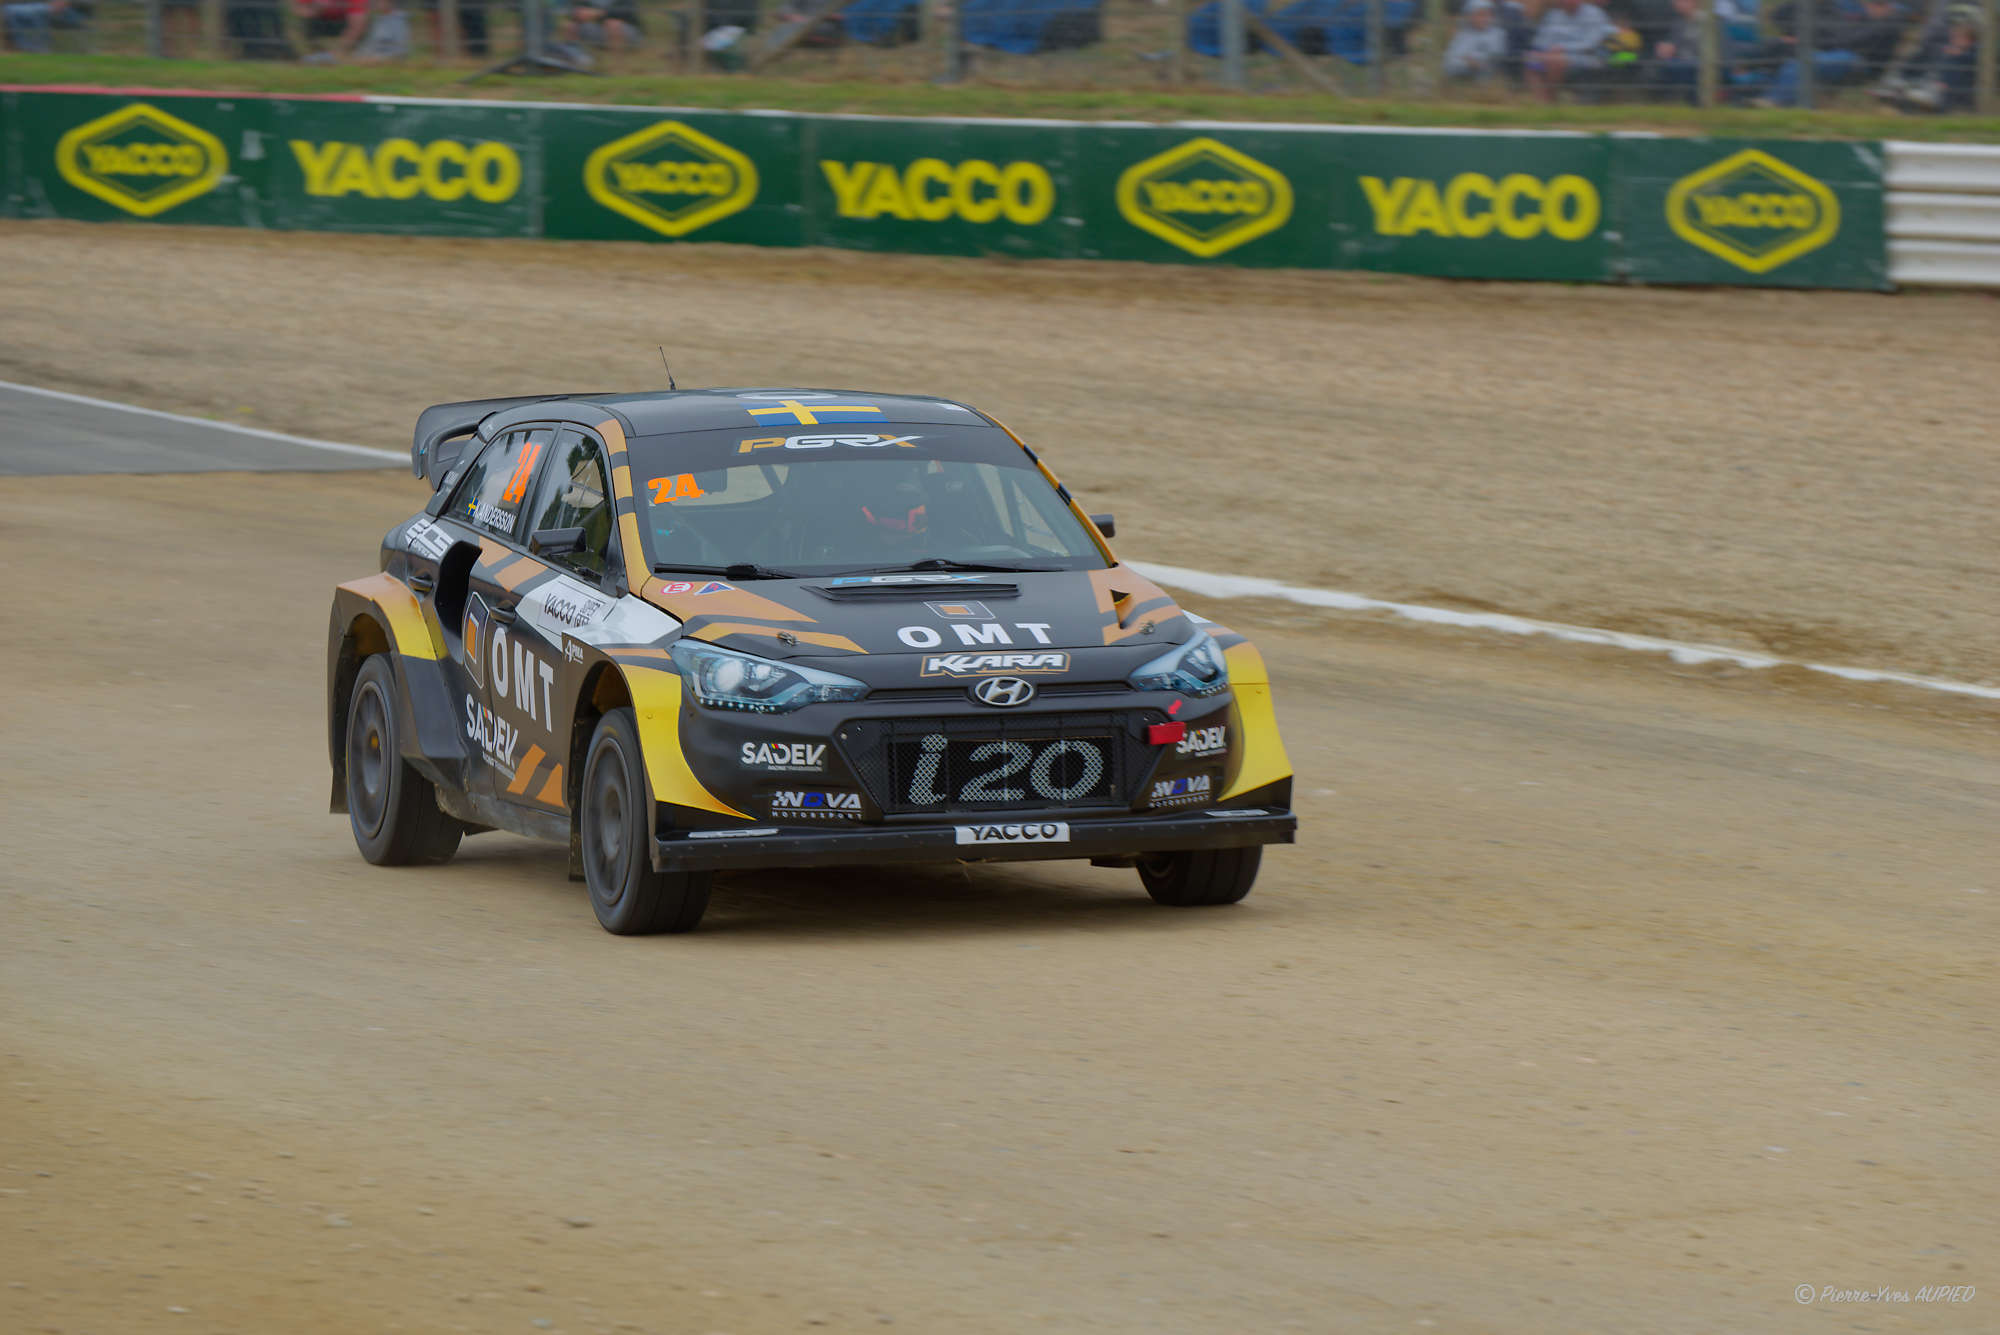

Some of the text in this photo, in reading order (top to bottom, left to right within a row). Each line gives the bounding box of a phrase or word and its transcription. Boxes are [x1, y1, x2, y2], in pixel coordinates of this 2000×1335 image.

[82, 142, 203, 176] YACCO
[290, 139, 521, 202] YACCO
[610, 159, 731, 194] YACCO
[821, 158, 1055, 225] YACCO
[1144, 180, 1266, 214] YACCO
[1359, 173, 1600, 240] YACCO
[1695, 193, 1815, 228] YACCO
[738, 434, 923, 453] PGRX
[648, 473, 704, 504] 24
[544, 593, 576, 624] YACCO
[897, 623, 1052, 648] OMT
[492, 627, 553, 733] OMT
[908, 733, 1104, 807] i20
[968, 823, 1059, 842] YACCO
